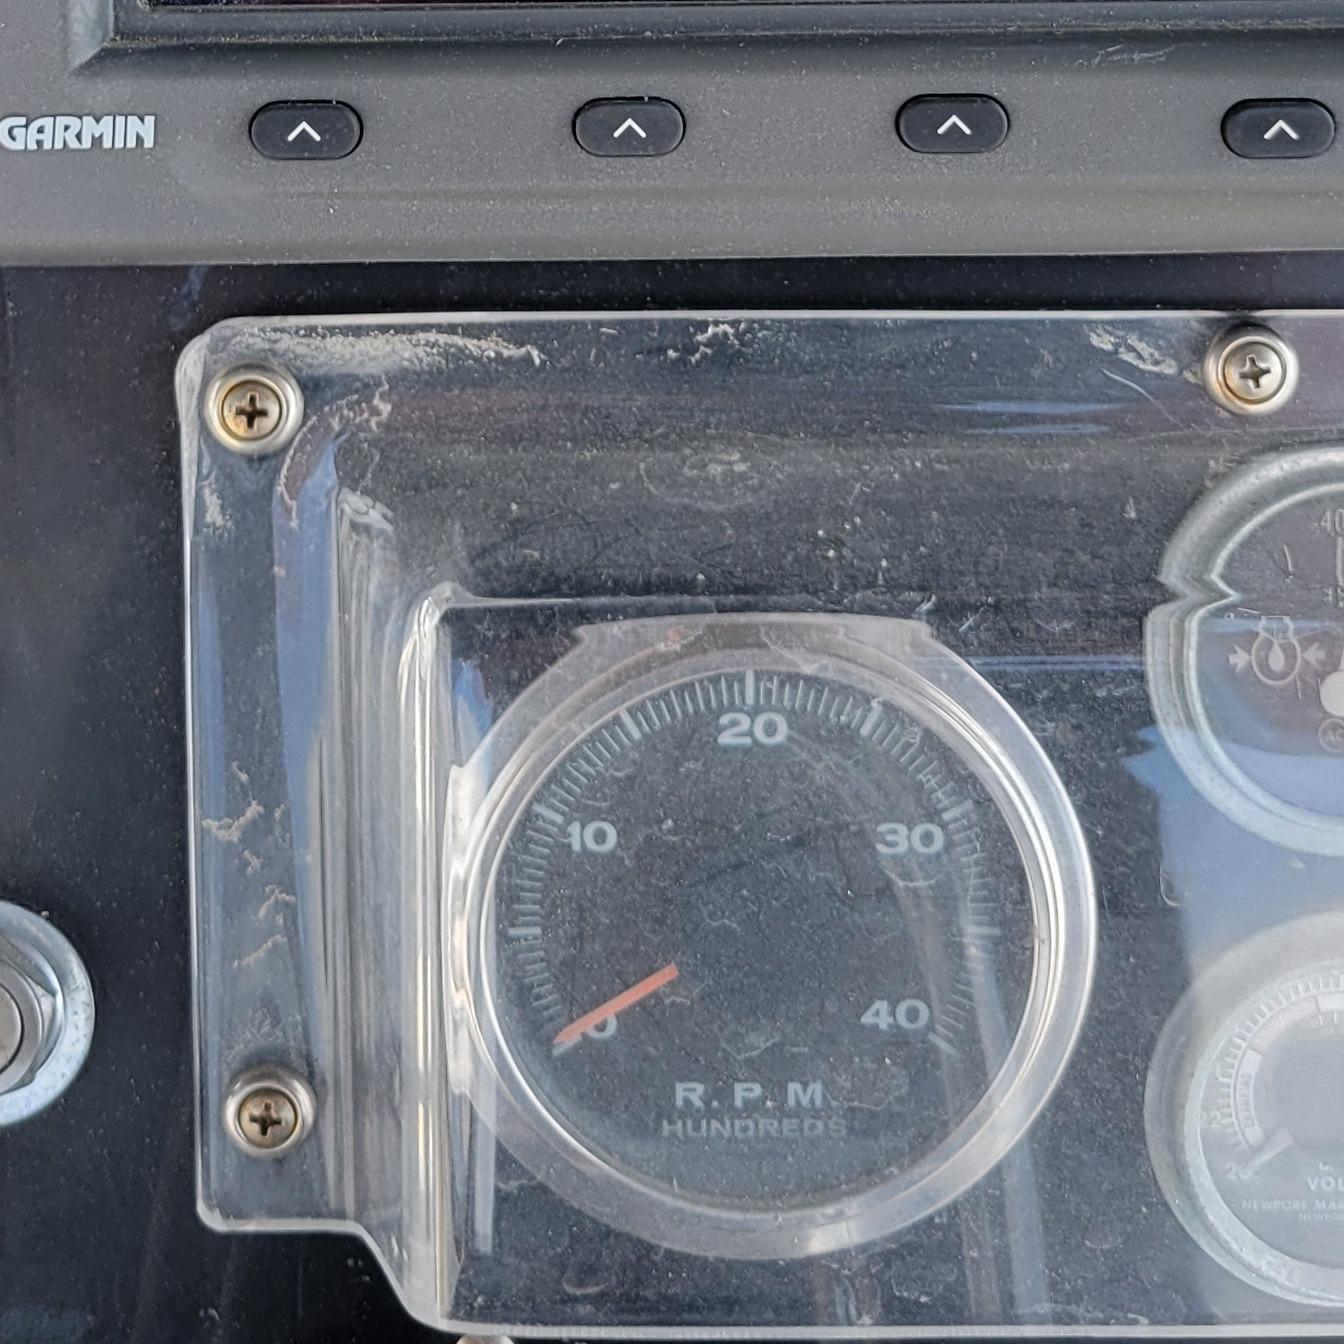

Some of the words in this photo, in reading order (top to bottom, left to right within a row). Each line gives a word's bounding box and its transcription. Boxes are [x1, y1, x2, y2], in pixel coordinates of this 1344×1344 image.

[716, 712, 789, 747] 20
[566, 819, 619, 855] 10
[875, 821, 947, 856] 30
[860, 998, 932, 1030] 40
[661, 1115, 849, 1141] HUNDREDS
